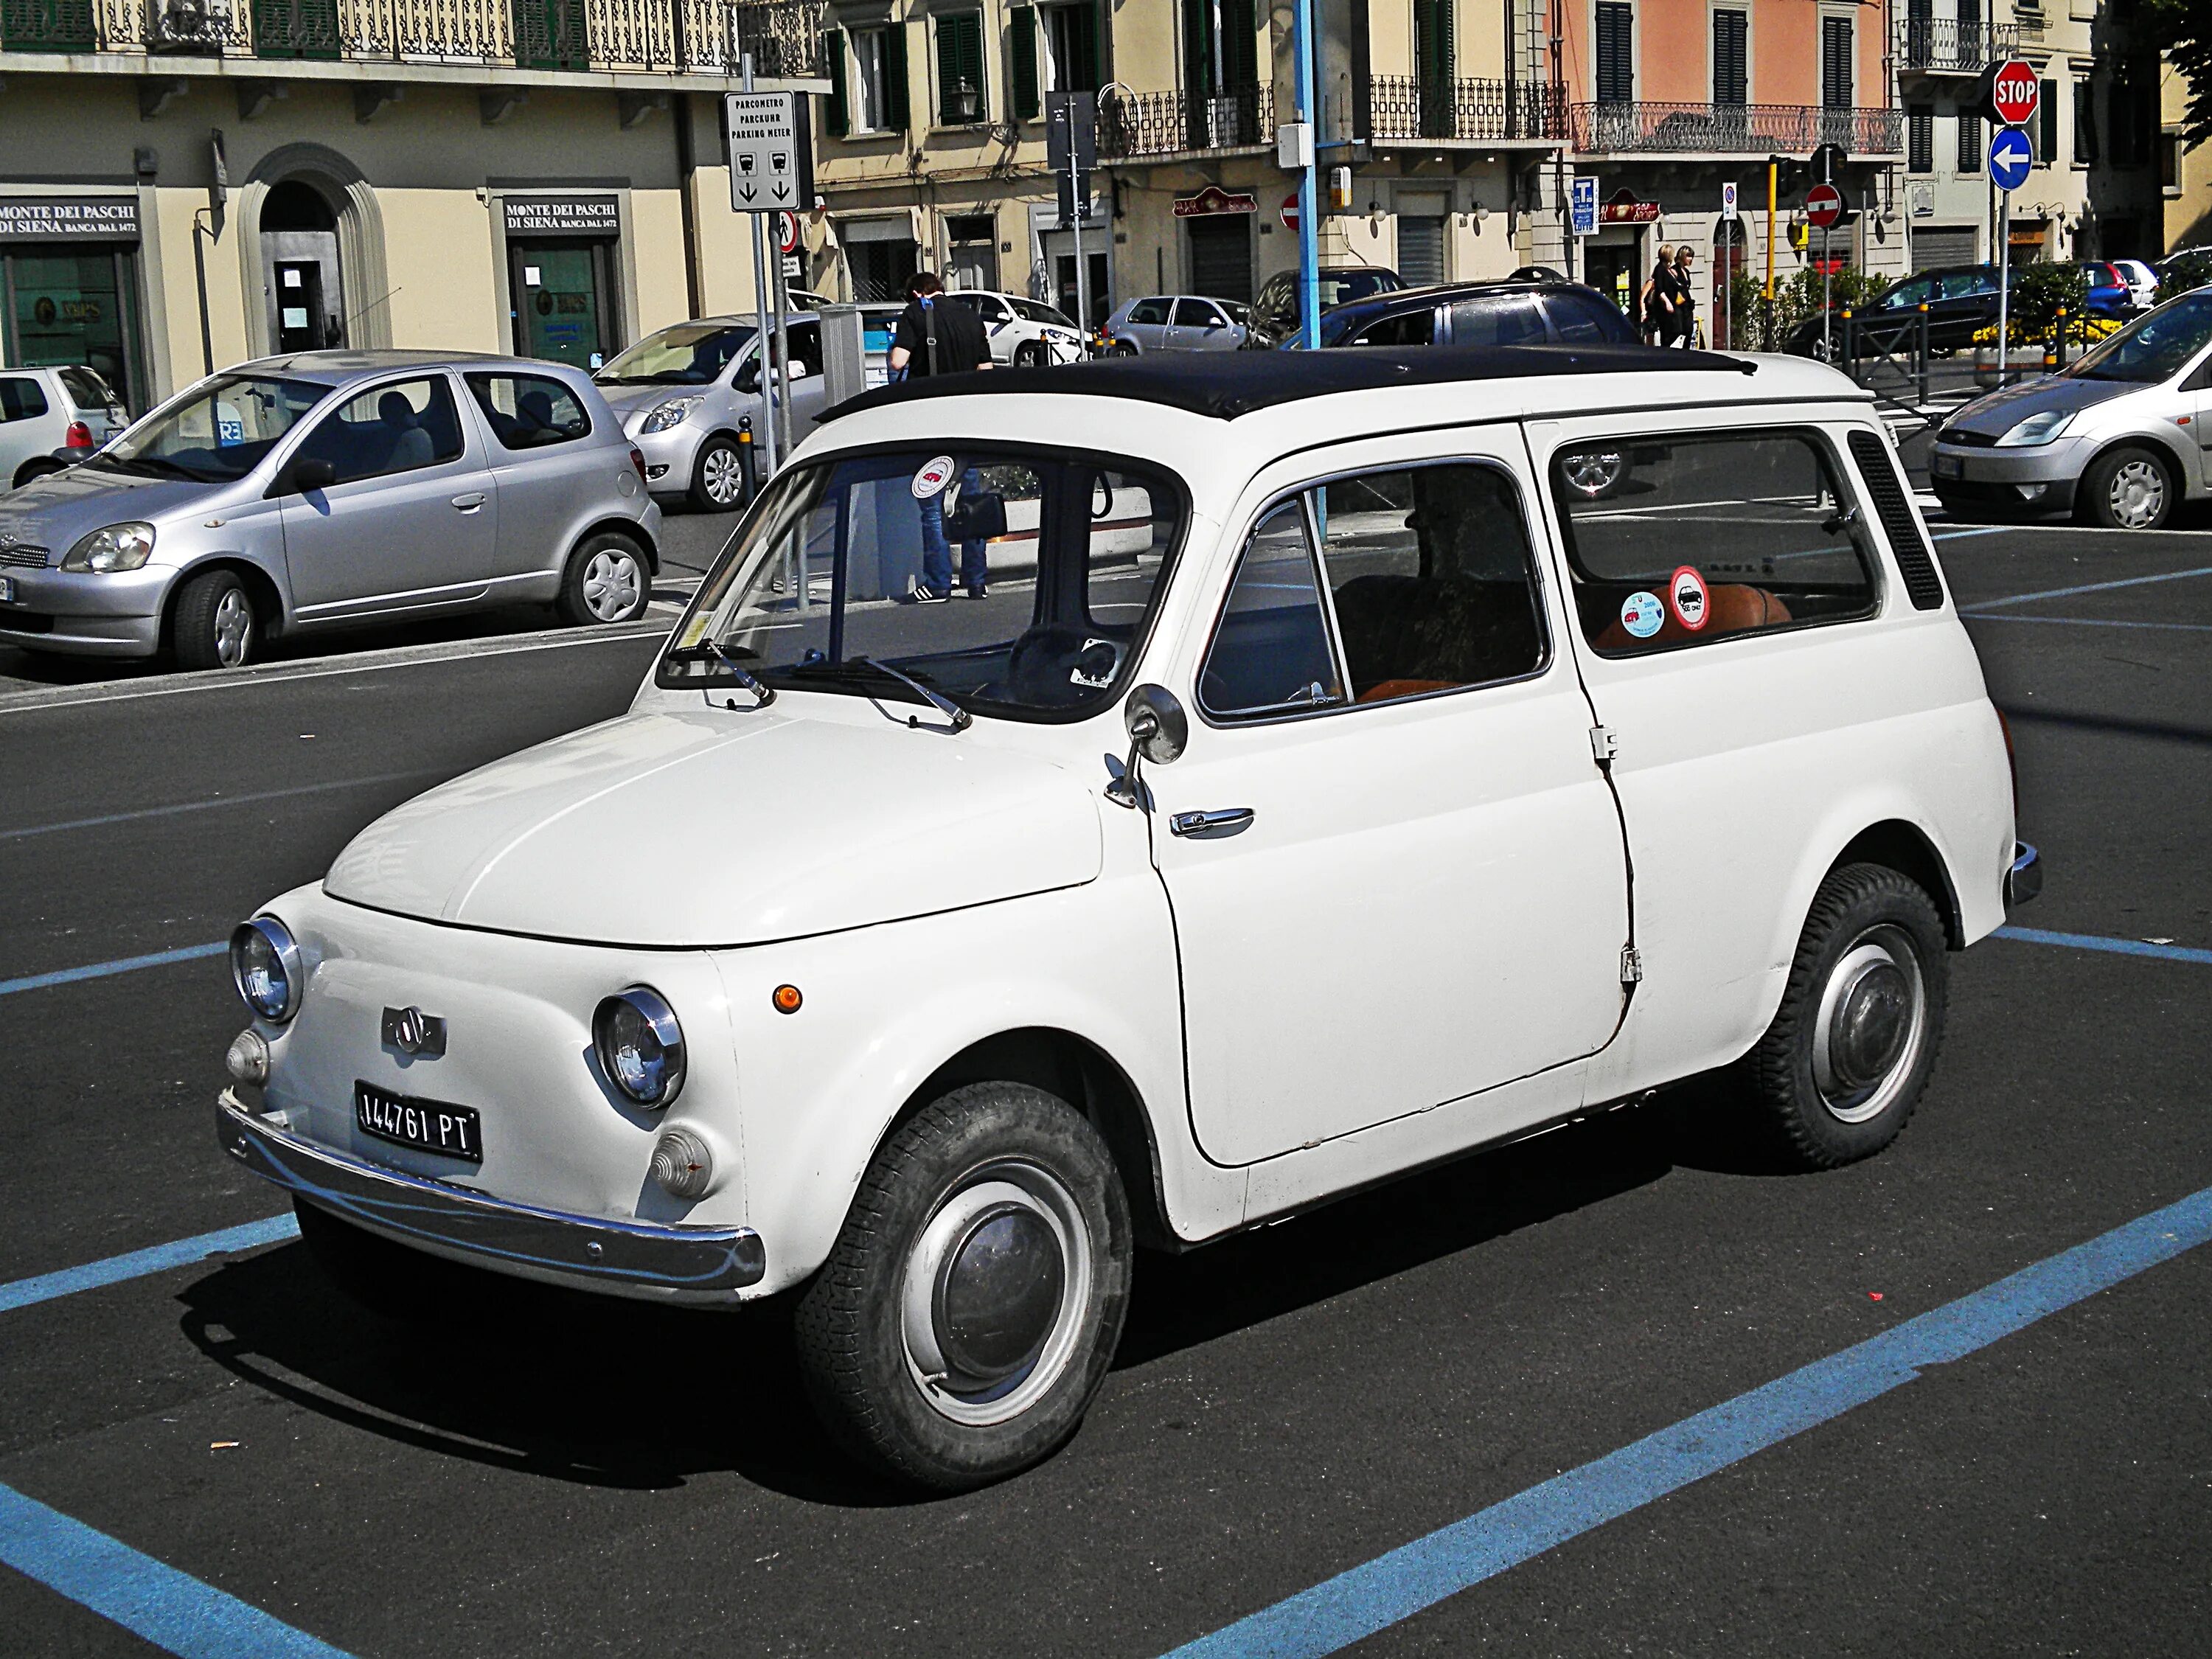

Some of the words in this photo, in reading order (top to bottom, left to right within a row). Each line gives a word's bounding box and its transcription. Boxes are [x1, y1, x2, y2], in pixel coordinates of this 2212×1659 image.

[1997, 80, 2036, 104] STOP
[735, 98, 784, 109] PARCOMETRO
[740, 114, 781, 124] PARCKUHR
[731, 129, 765, 139] PARKING
[768, 128, 791, 138] METER
[1576, 181, 1591, 203] T
[0, 206, 52, 218] MONTE
[54, 206, 81, 219] DEI
[83, 206, 136, 219] PASCHI
[507, 204, 551, 216] MONTE
[552, 204, 573, 216] DEI
[575, 204, 616, 215] PASCHI
[0, 220, 15, 233] DI
[17, 220, 63, 233] SIENA
[65, 223, 97, 233] BANCA
[97, 223, 117, 232] DAL
[119, 223, 137, 232] 1472
[507, 217, 521, 229] DI
[523, 217, 560, 229] SIENA
[561, 219, 587, 228] BANCA
[587, 219, 602, 228] DAL
[602, 219, 617, 227] 1472
[364, 1094, 428, 1142] 144761
[439, 1114, 467, 1150] PT
